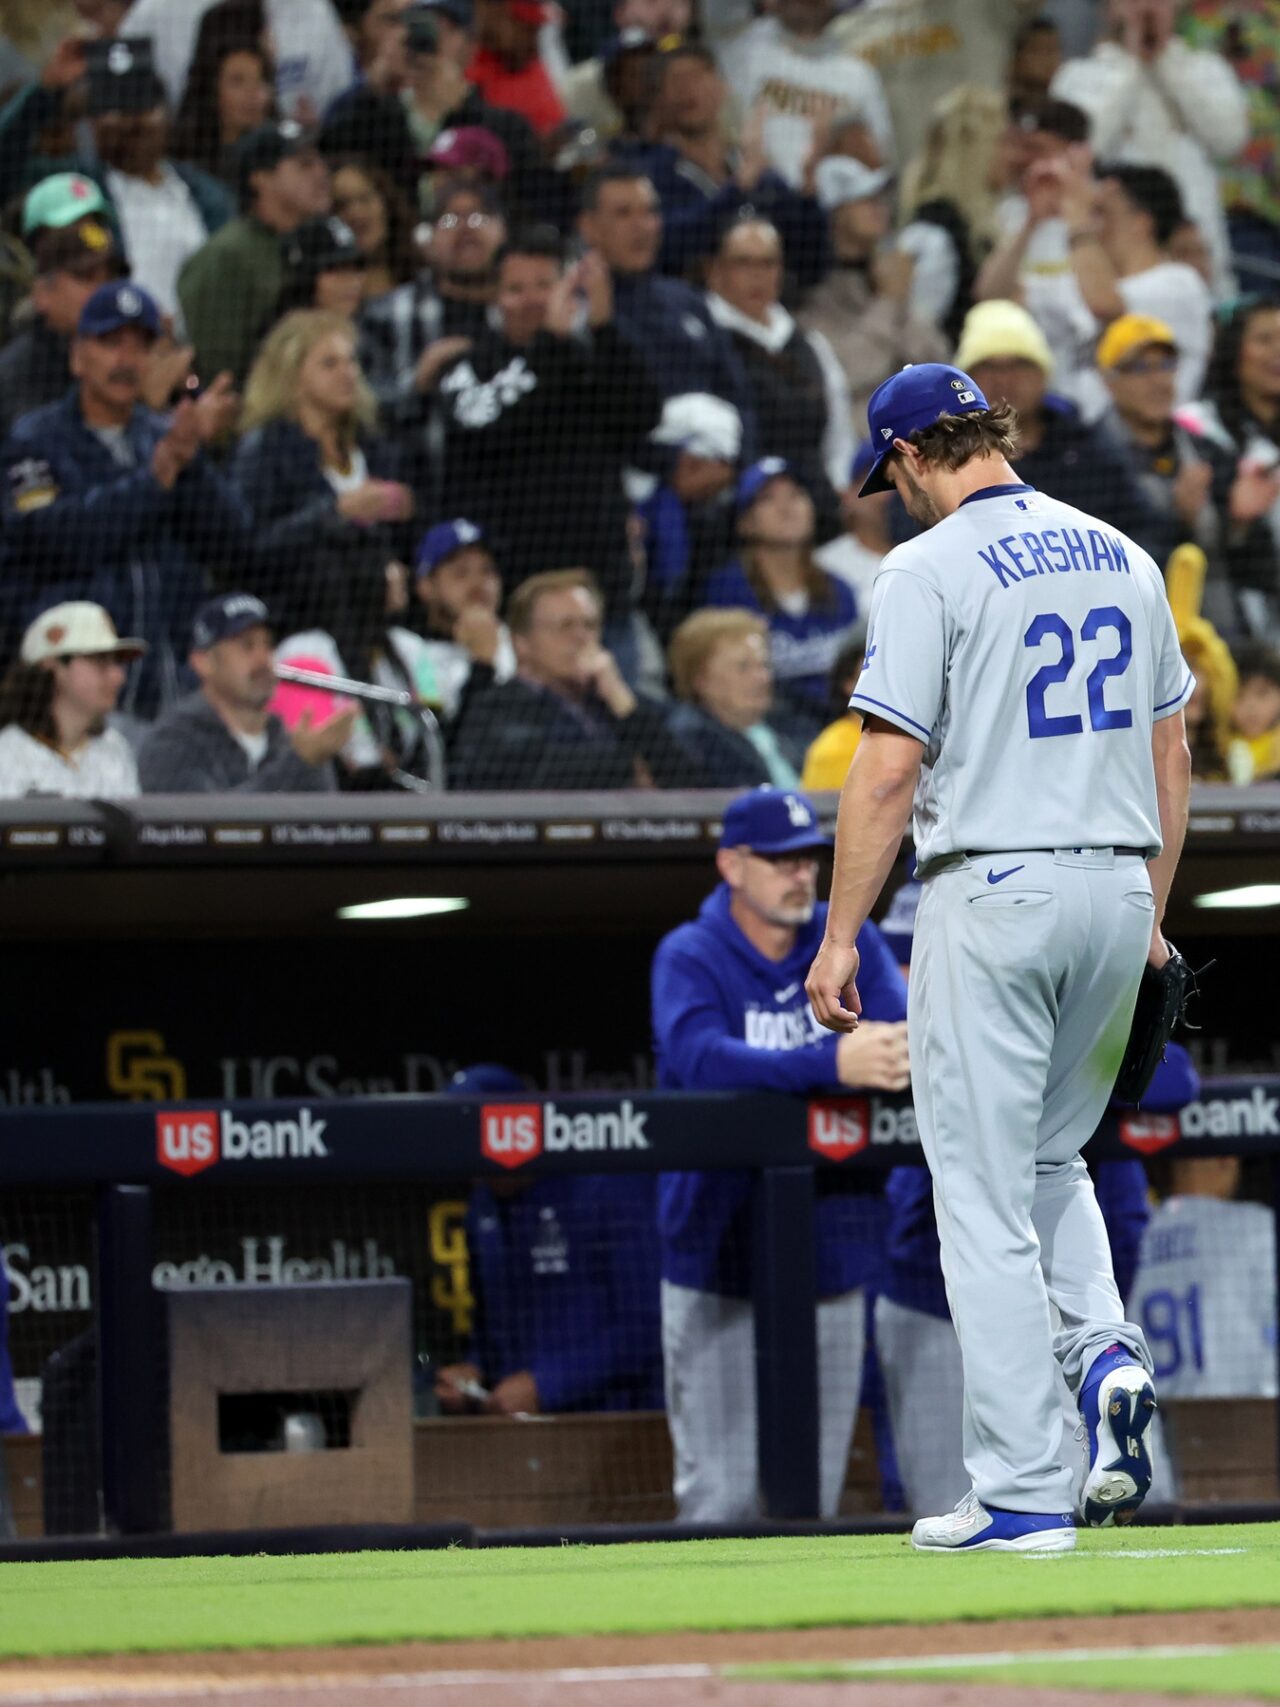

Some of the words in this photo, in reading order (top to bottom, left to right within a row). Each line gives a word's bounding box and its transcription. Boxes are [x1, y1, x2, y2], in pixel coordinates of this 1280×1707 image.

[977, 528, 1131, 589] KERSHAW
[1023, 605, 1133, 739] 22
[162, 1123, 214, 1160] us
[220, 1109, 328, 1158] bank
[486, 1115, 537, 1151] us
[543, 1101, 648, 1150] bank
[815, 1110, 863, 1145] us
[871, 1098, 919, 1144] ba
[0, 1244, 91, 1313] San
[1143, 1283, 1205, 1379] 91
